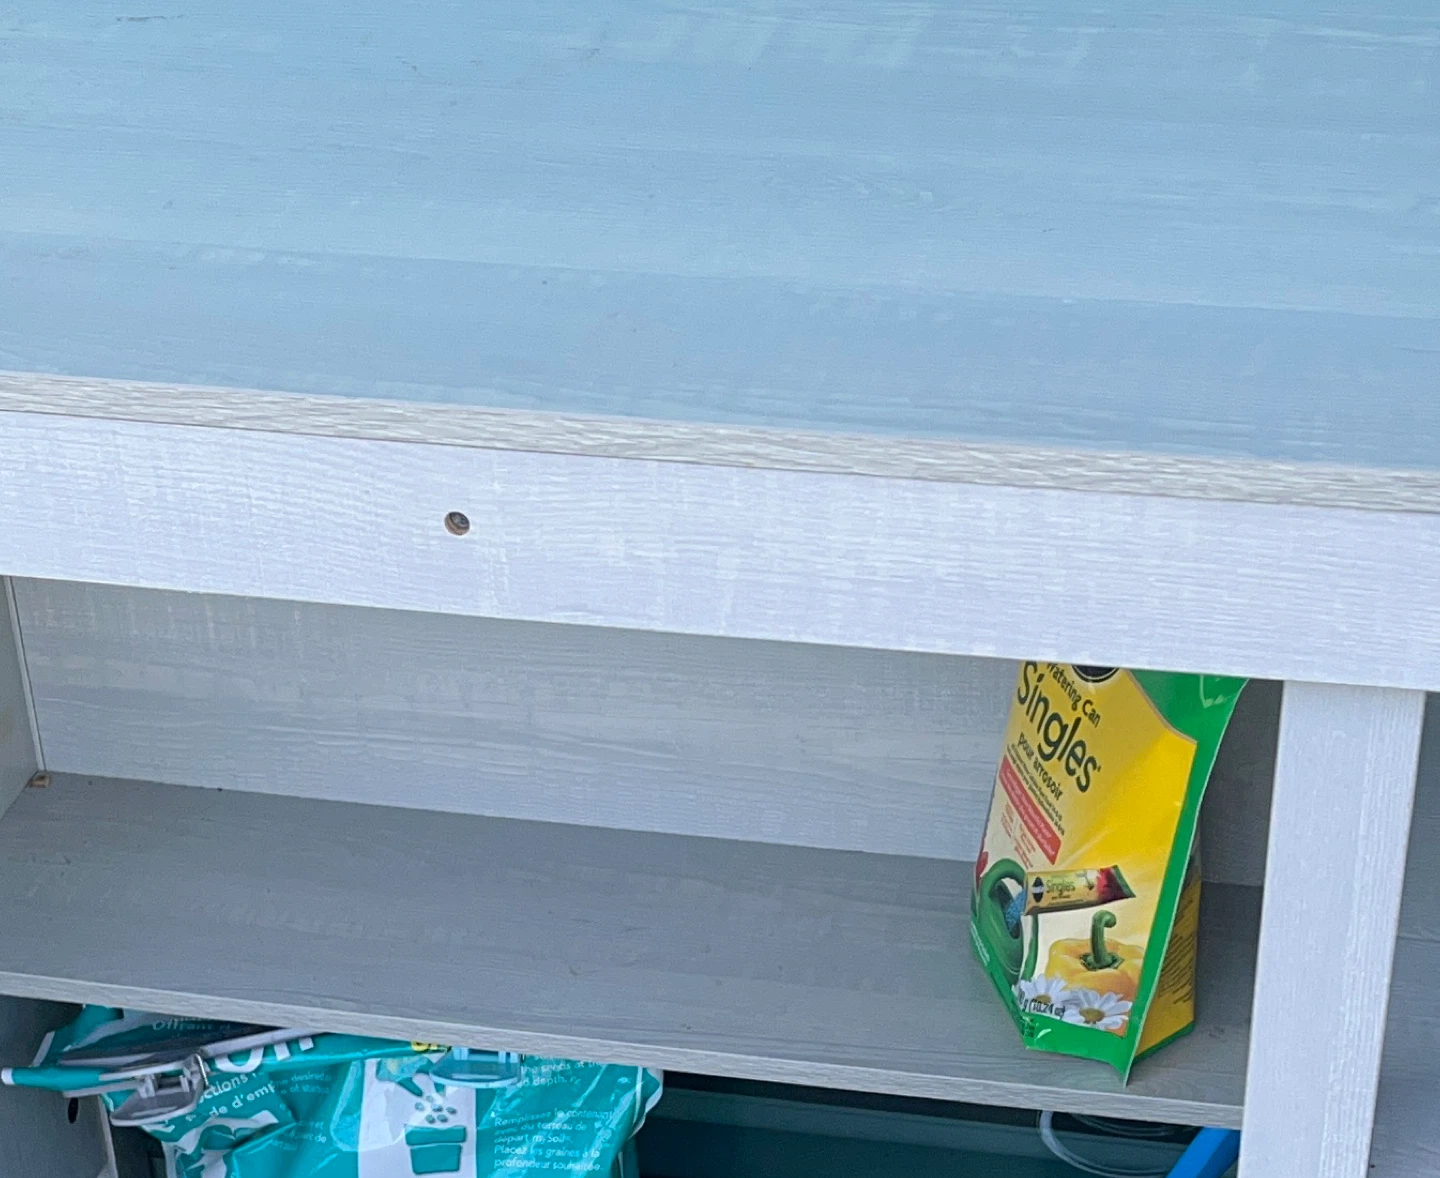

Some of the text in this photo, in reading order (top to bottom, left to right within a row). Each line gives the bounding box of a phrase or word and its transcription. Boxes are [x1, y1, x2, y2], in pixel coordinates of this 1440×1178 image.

[1018, 660, 1099, 793] Singles
[1082, 699, 1101, 728] Can
[1033, 756, 1063, 801] arrosoir
